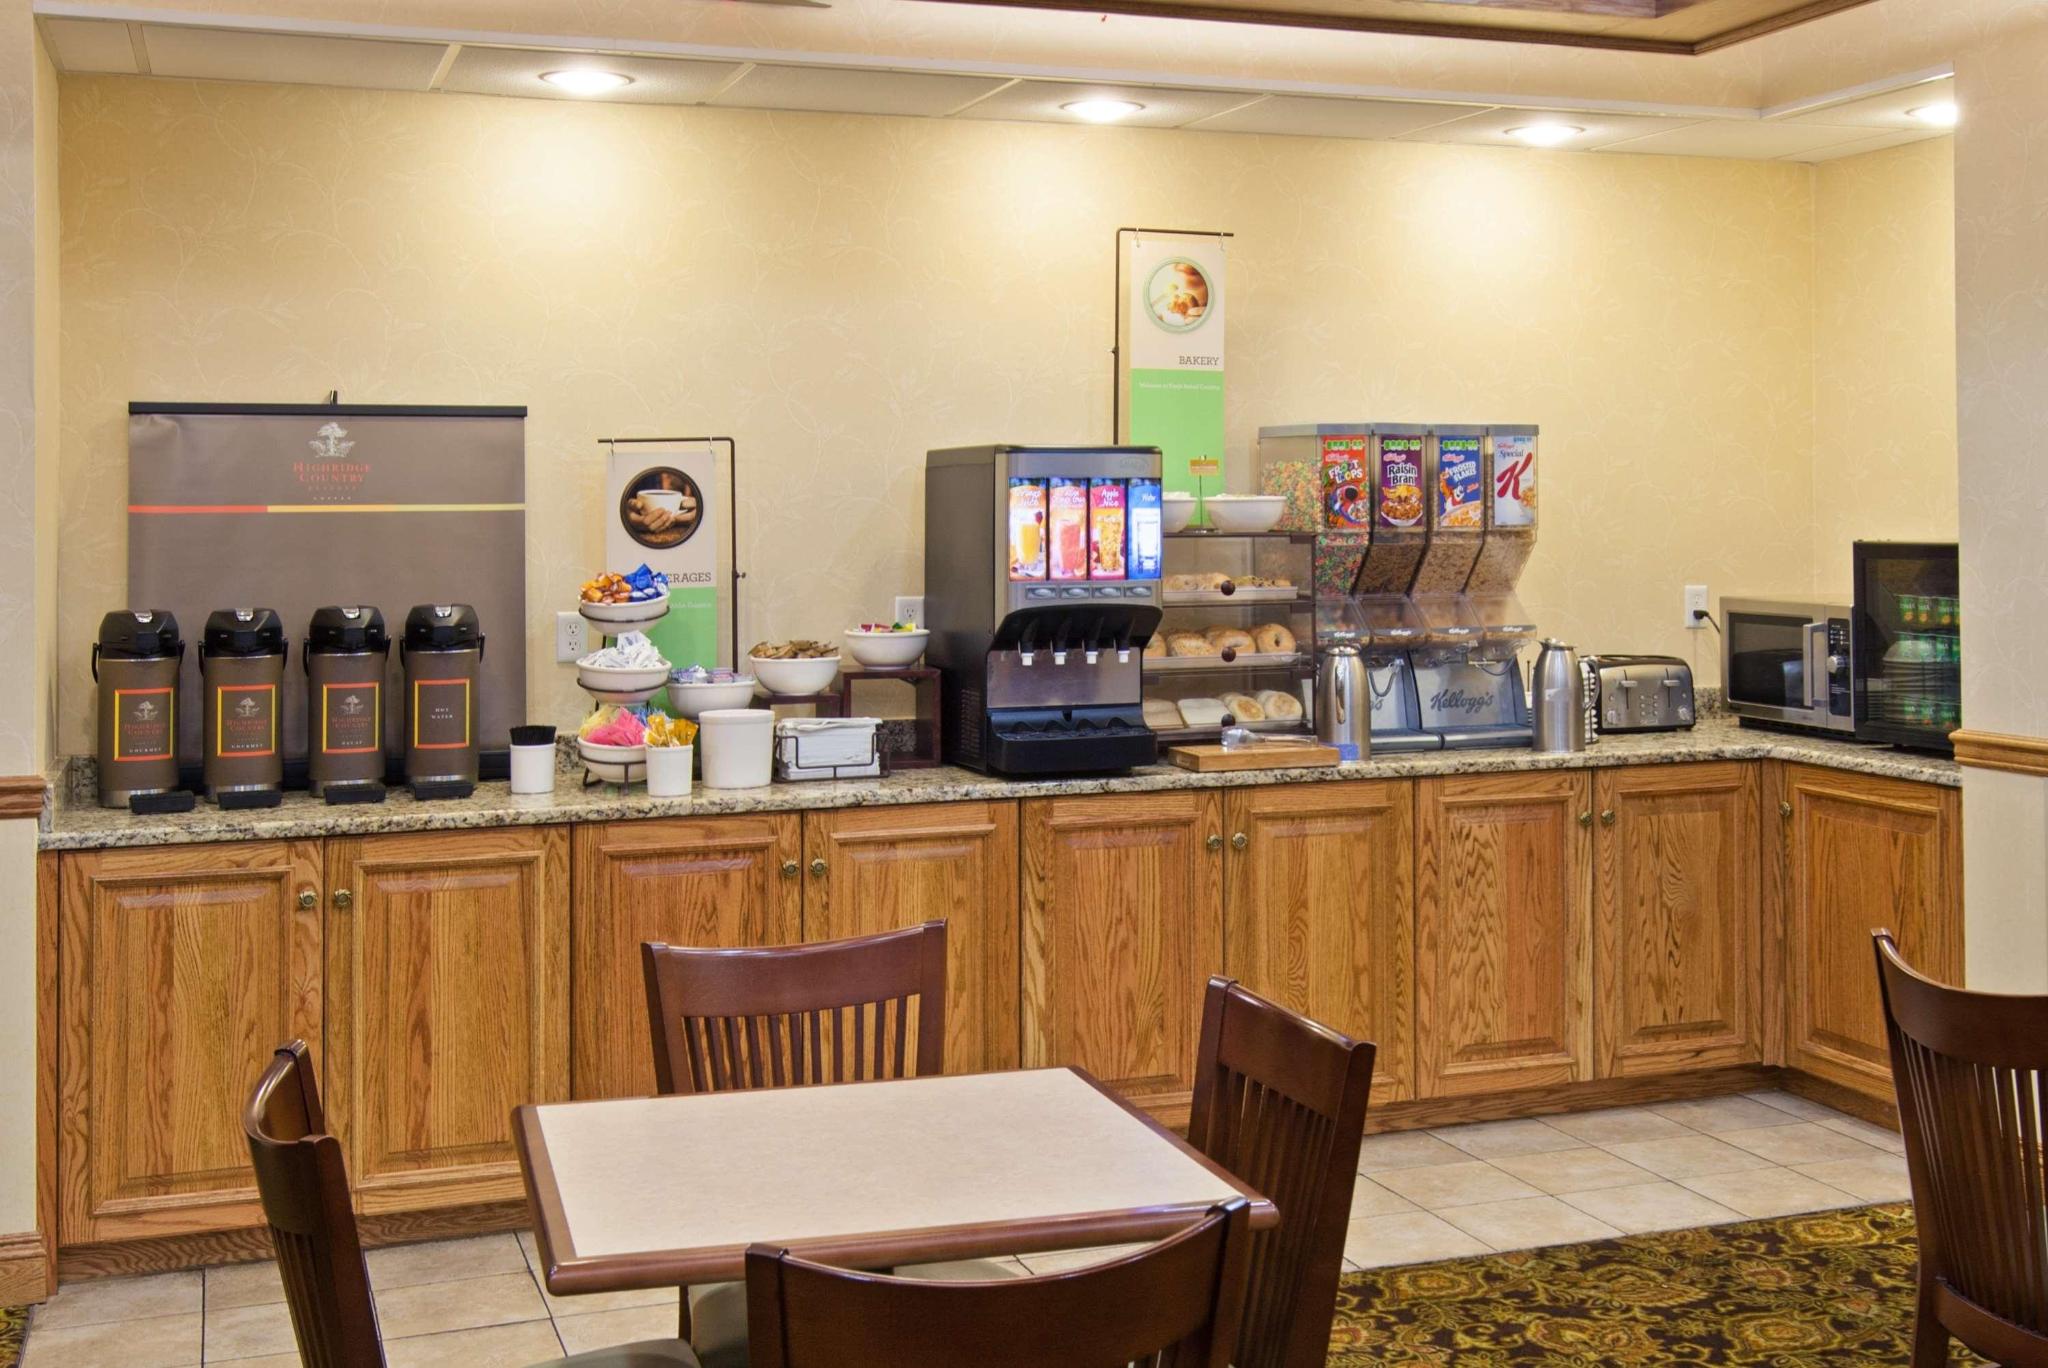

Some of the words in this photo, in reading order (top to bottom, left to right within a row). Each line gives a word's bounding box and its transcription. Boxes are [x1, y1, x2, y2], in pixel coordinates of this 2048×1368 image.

[1178, 355, 1219, 366] BAKERY
[1500, 447, 1524, 459] Special
[1387, 462, 1417, 476] Raisin
[1391, 475, 1416, 486] Bran
[1496, 452, 1532, 499] K
[667, 571, 711, 583] ERAGES
[1430, 689, 1494, 714] Kellogg's
